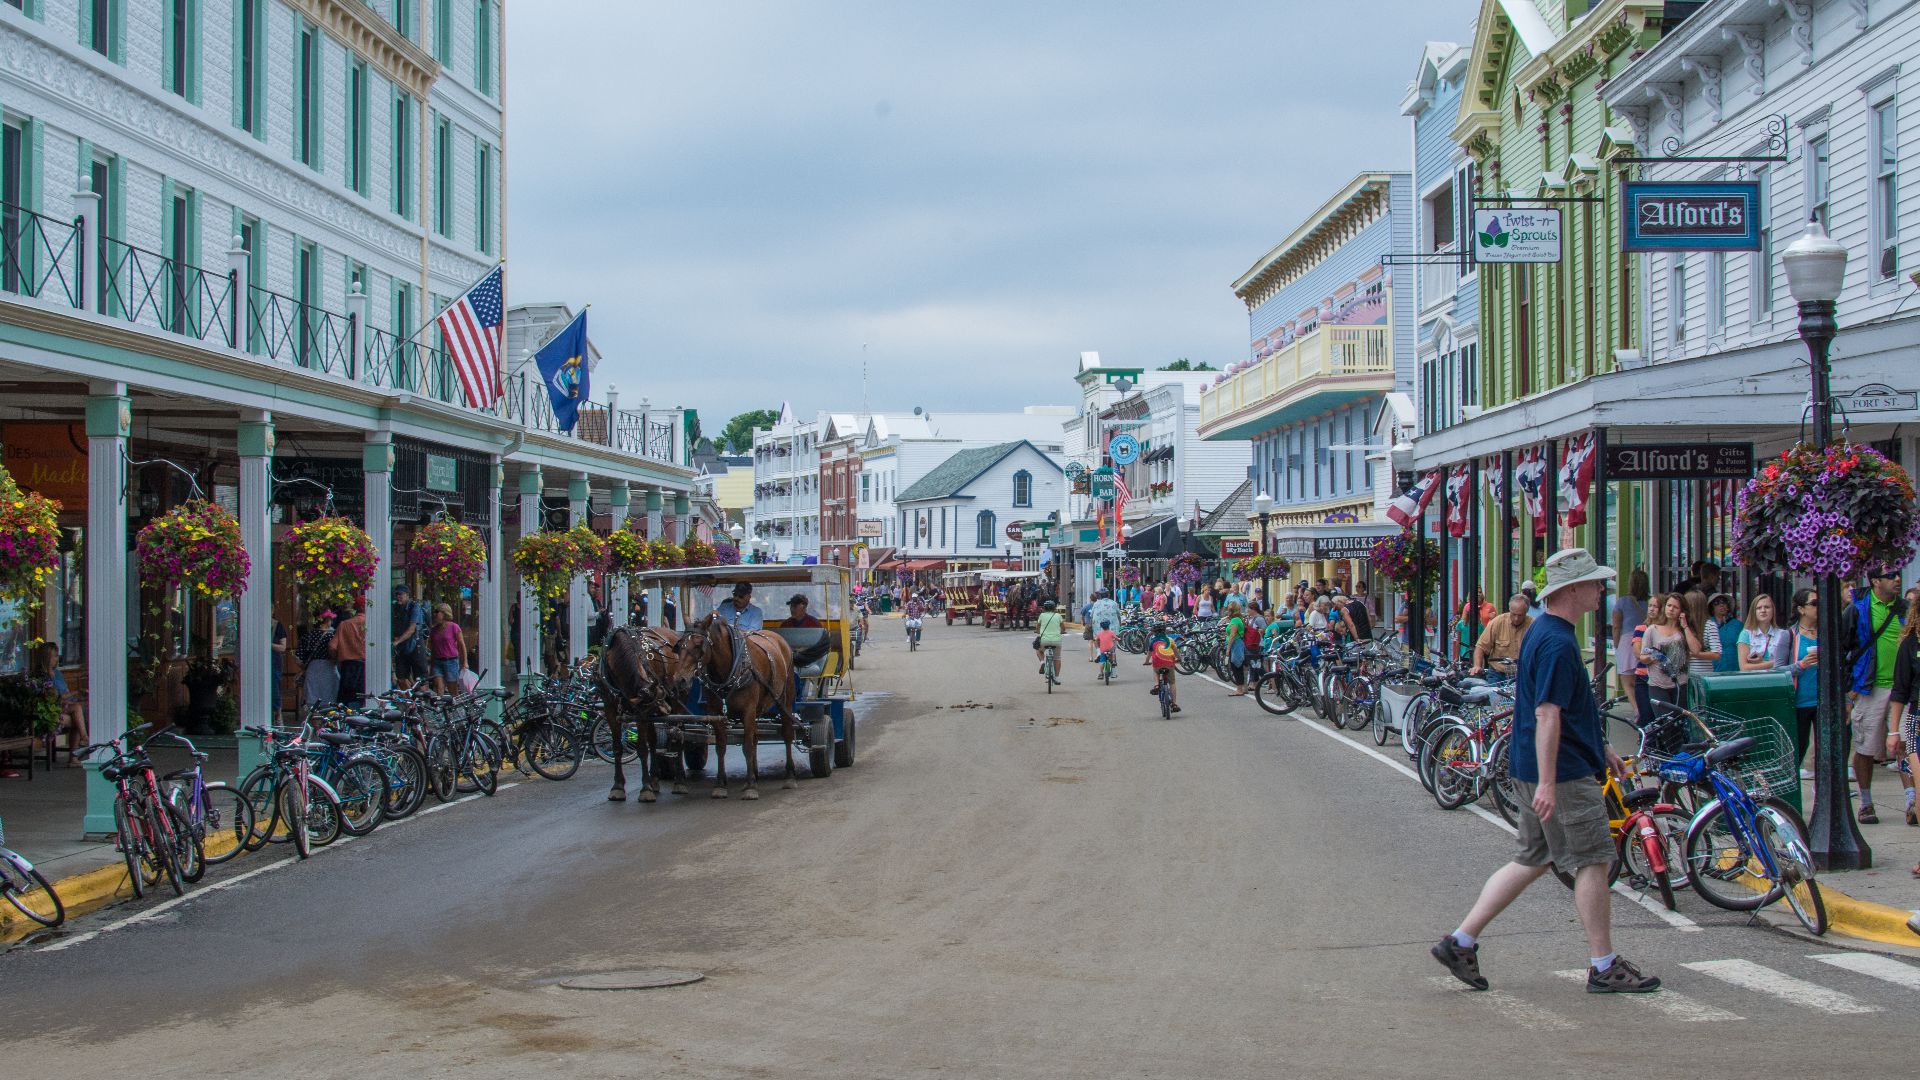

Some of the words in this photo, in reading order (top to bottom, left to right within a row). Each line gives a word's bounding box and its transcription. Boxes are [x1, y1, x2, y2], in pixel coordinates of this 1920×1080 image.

[1503, 212, 1535, 227] Twist
[1641, 201, 1742, 227] Alford's
[1511, 228, 1558, 243] Sprouts
[1853, 399, 1879, 408] FORT
[1884, 398, 1900, 406] ST.
[1719, 447, 1745, 456] Gifts
[1619, 449, 1709, 472] Alford's
[1093, 474, 1114, 482] HORN
[1100, 488, 1113, 496] BAR
[1319, 537, 1374, 550] MURDICKS
